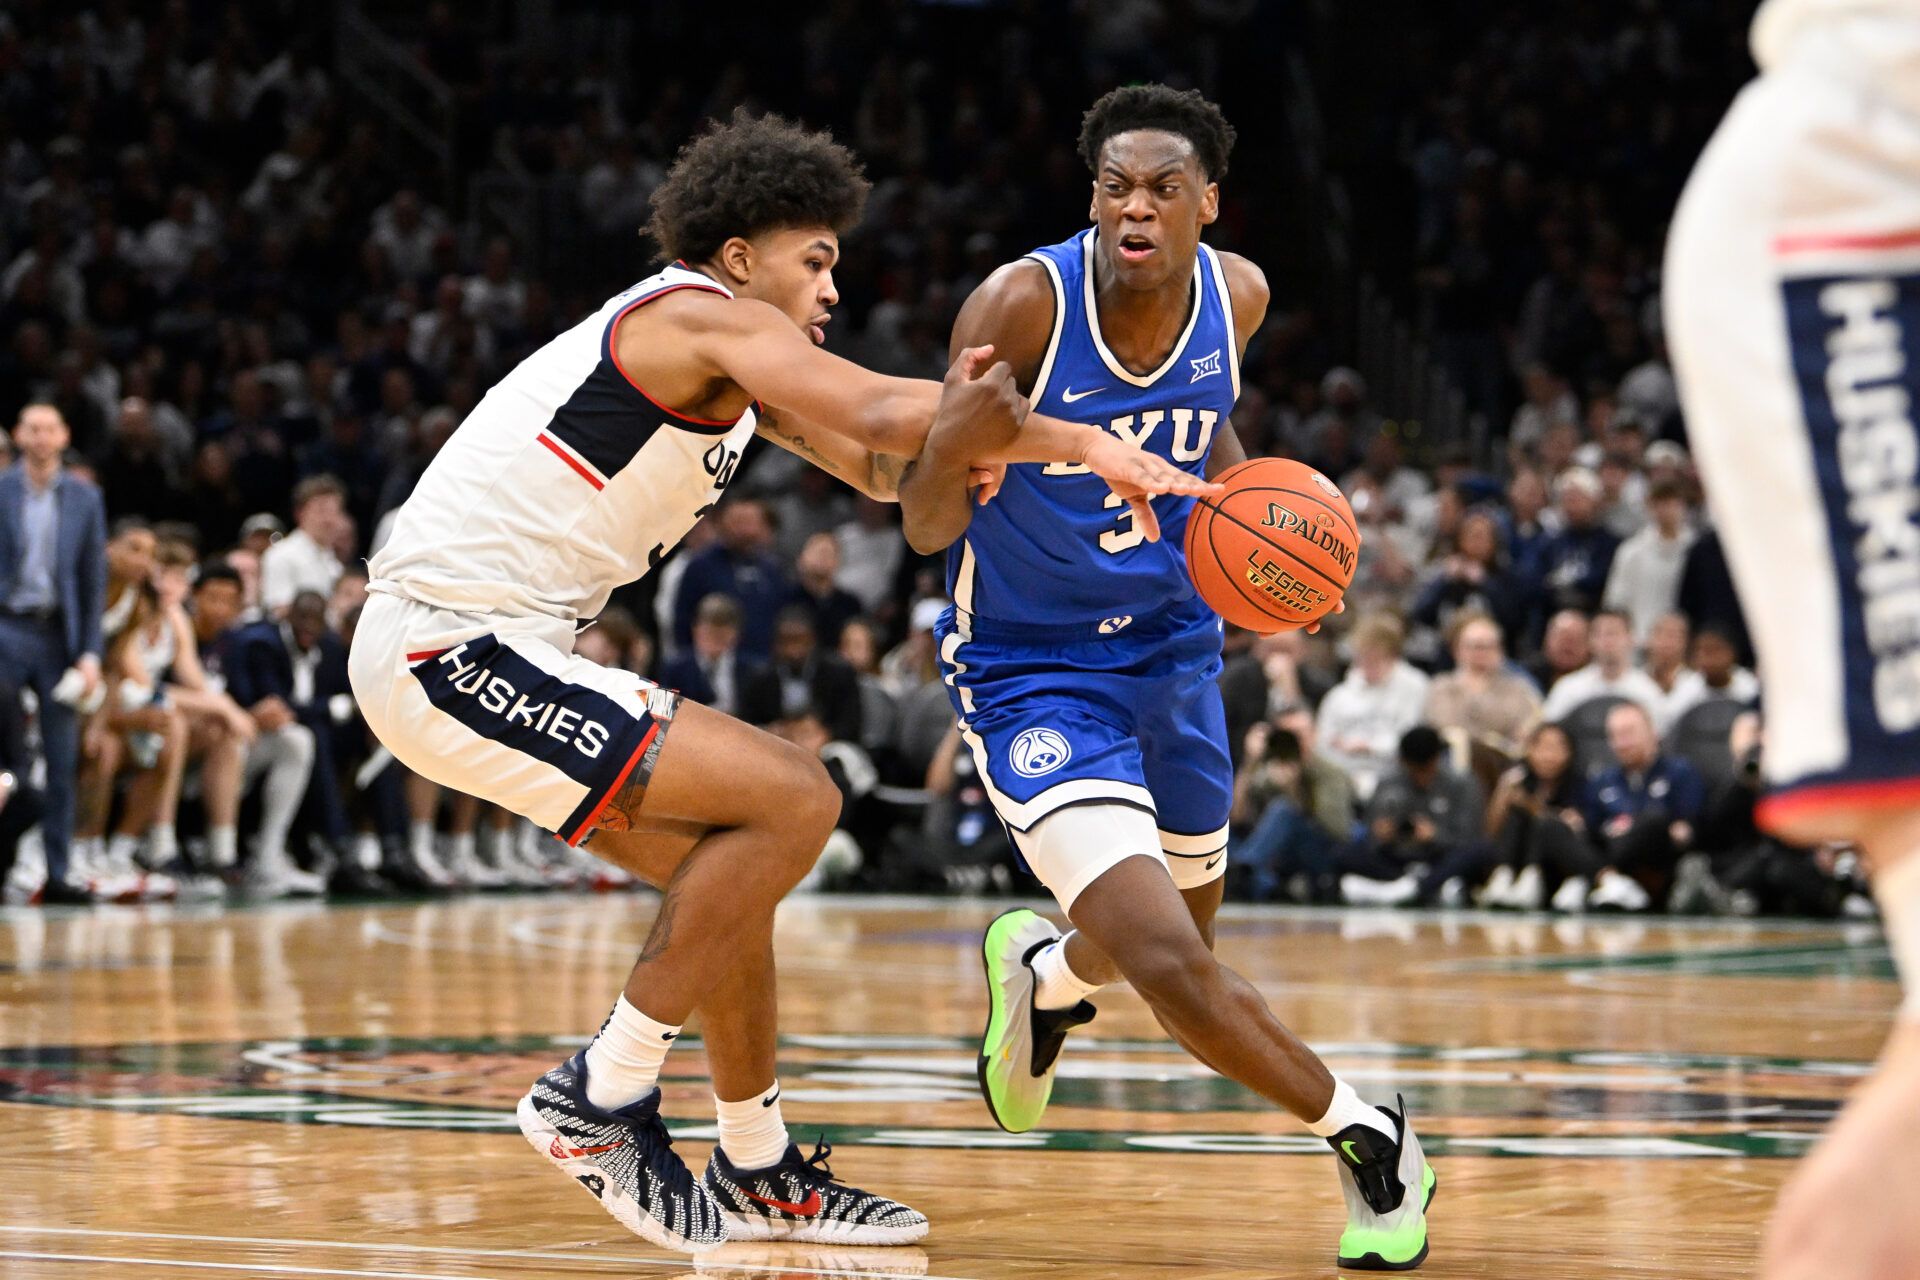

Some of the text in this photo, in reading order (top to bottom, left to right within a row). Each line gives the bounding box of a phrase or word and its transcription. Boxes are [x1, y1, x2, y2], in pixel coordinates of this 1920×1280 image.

[1098, 491, 1157, 555] 3
[1260, 502, 1356, 577] SPALDING
[1817, 279, 1920, 734] HUSKIES
[1247, 548, 1331, 606] LEGACY
[438, 642, 611, 760] HUSKIES
